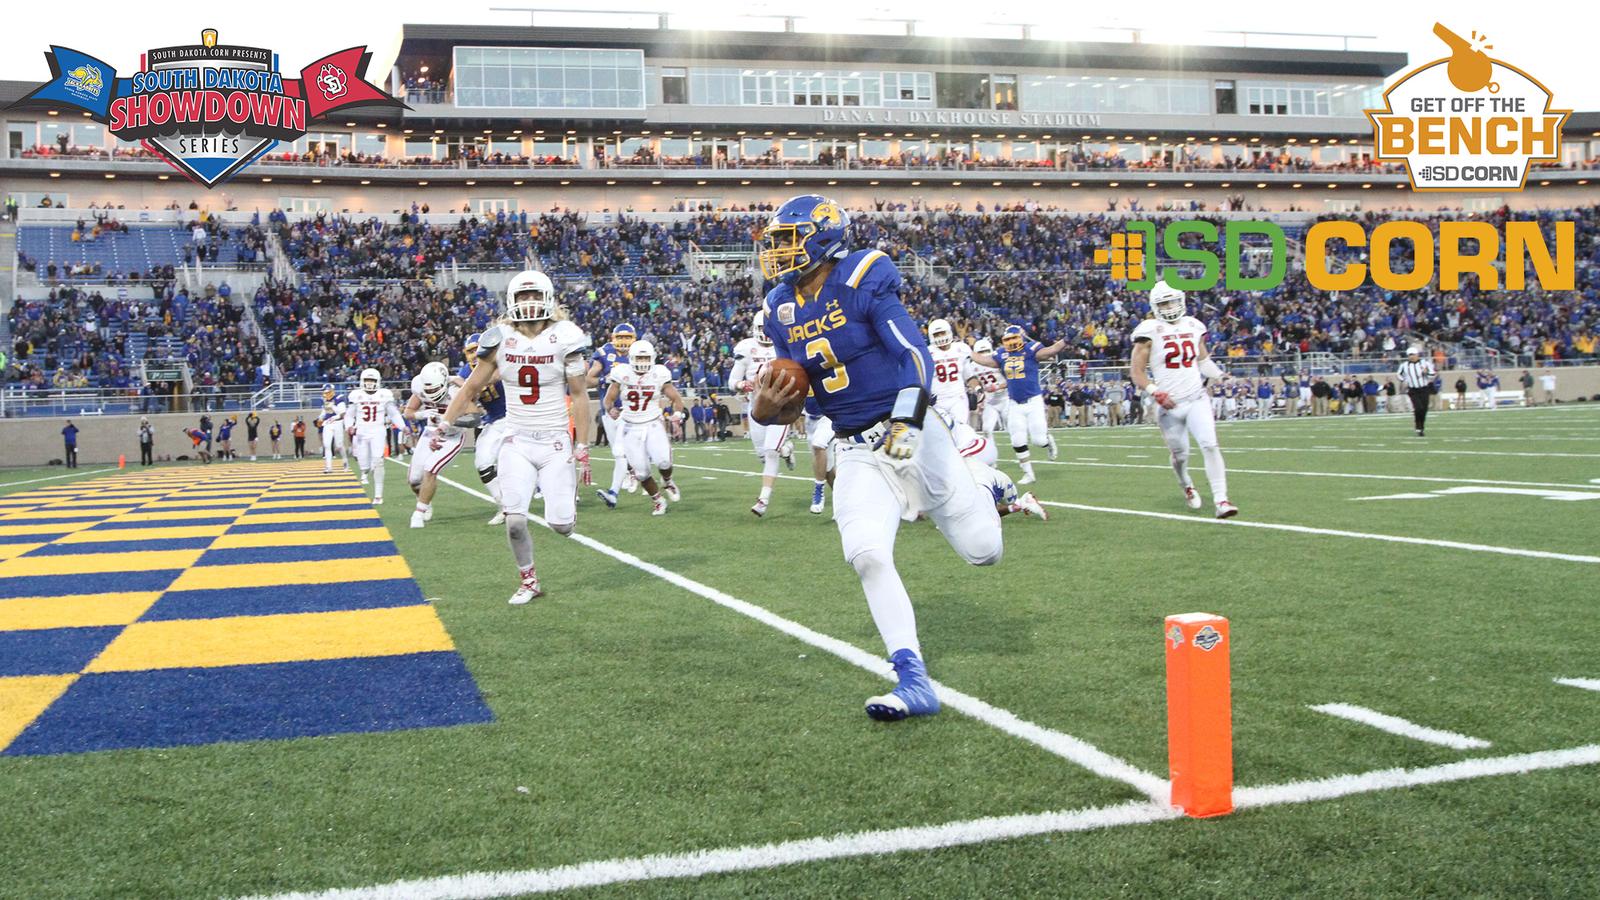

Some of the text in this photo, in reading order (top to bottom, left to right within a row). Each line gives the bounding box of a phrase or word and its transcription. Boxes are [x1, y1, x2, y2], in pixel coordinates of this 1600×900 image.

[823, 109, 1101, 126] DANA J. DYKHOUSE STADIUM
[787, 308, 847, 344] JACKS
[505, 353, 554, 365] SOUTH DAKOTA
[1164, 340, 1196, 369] 20
[805, 337, 850, 394] 3
[935, 363, 959, 383] 92
[518, 365, 540, 405] 9
[627, 390, 655, 411] 97
[362, 405, 377, 422] 31
